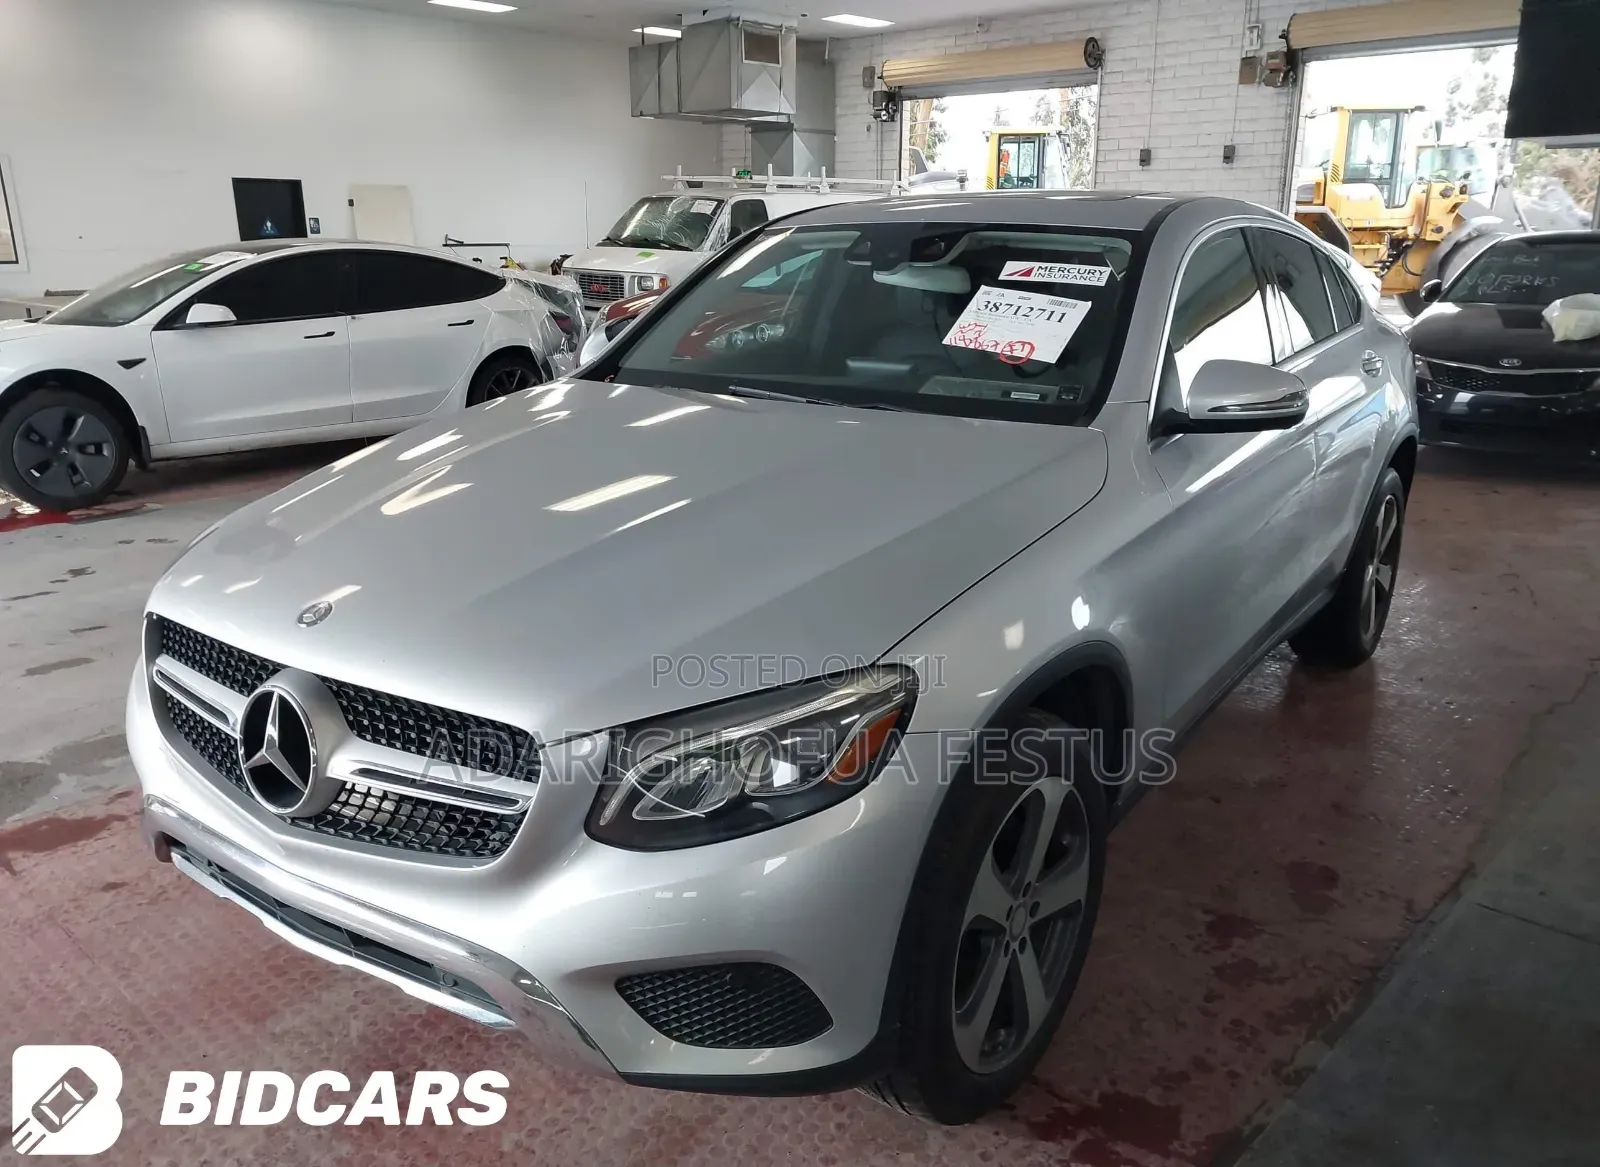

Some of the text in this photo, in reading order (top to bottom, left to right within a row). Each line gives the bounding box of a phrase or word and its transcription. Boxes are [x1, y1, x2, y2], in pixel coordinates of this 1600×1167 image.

[1036, 265, 1107, 277] MERCURY
[1033, 272, 1105, 283] INSURANCE
[977, 300, 1067, 323] 38712711
